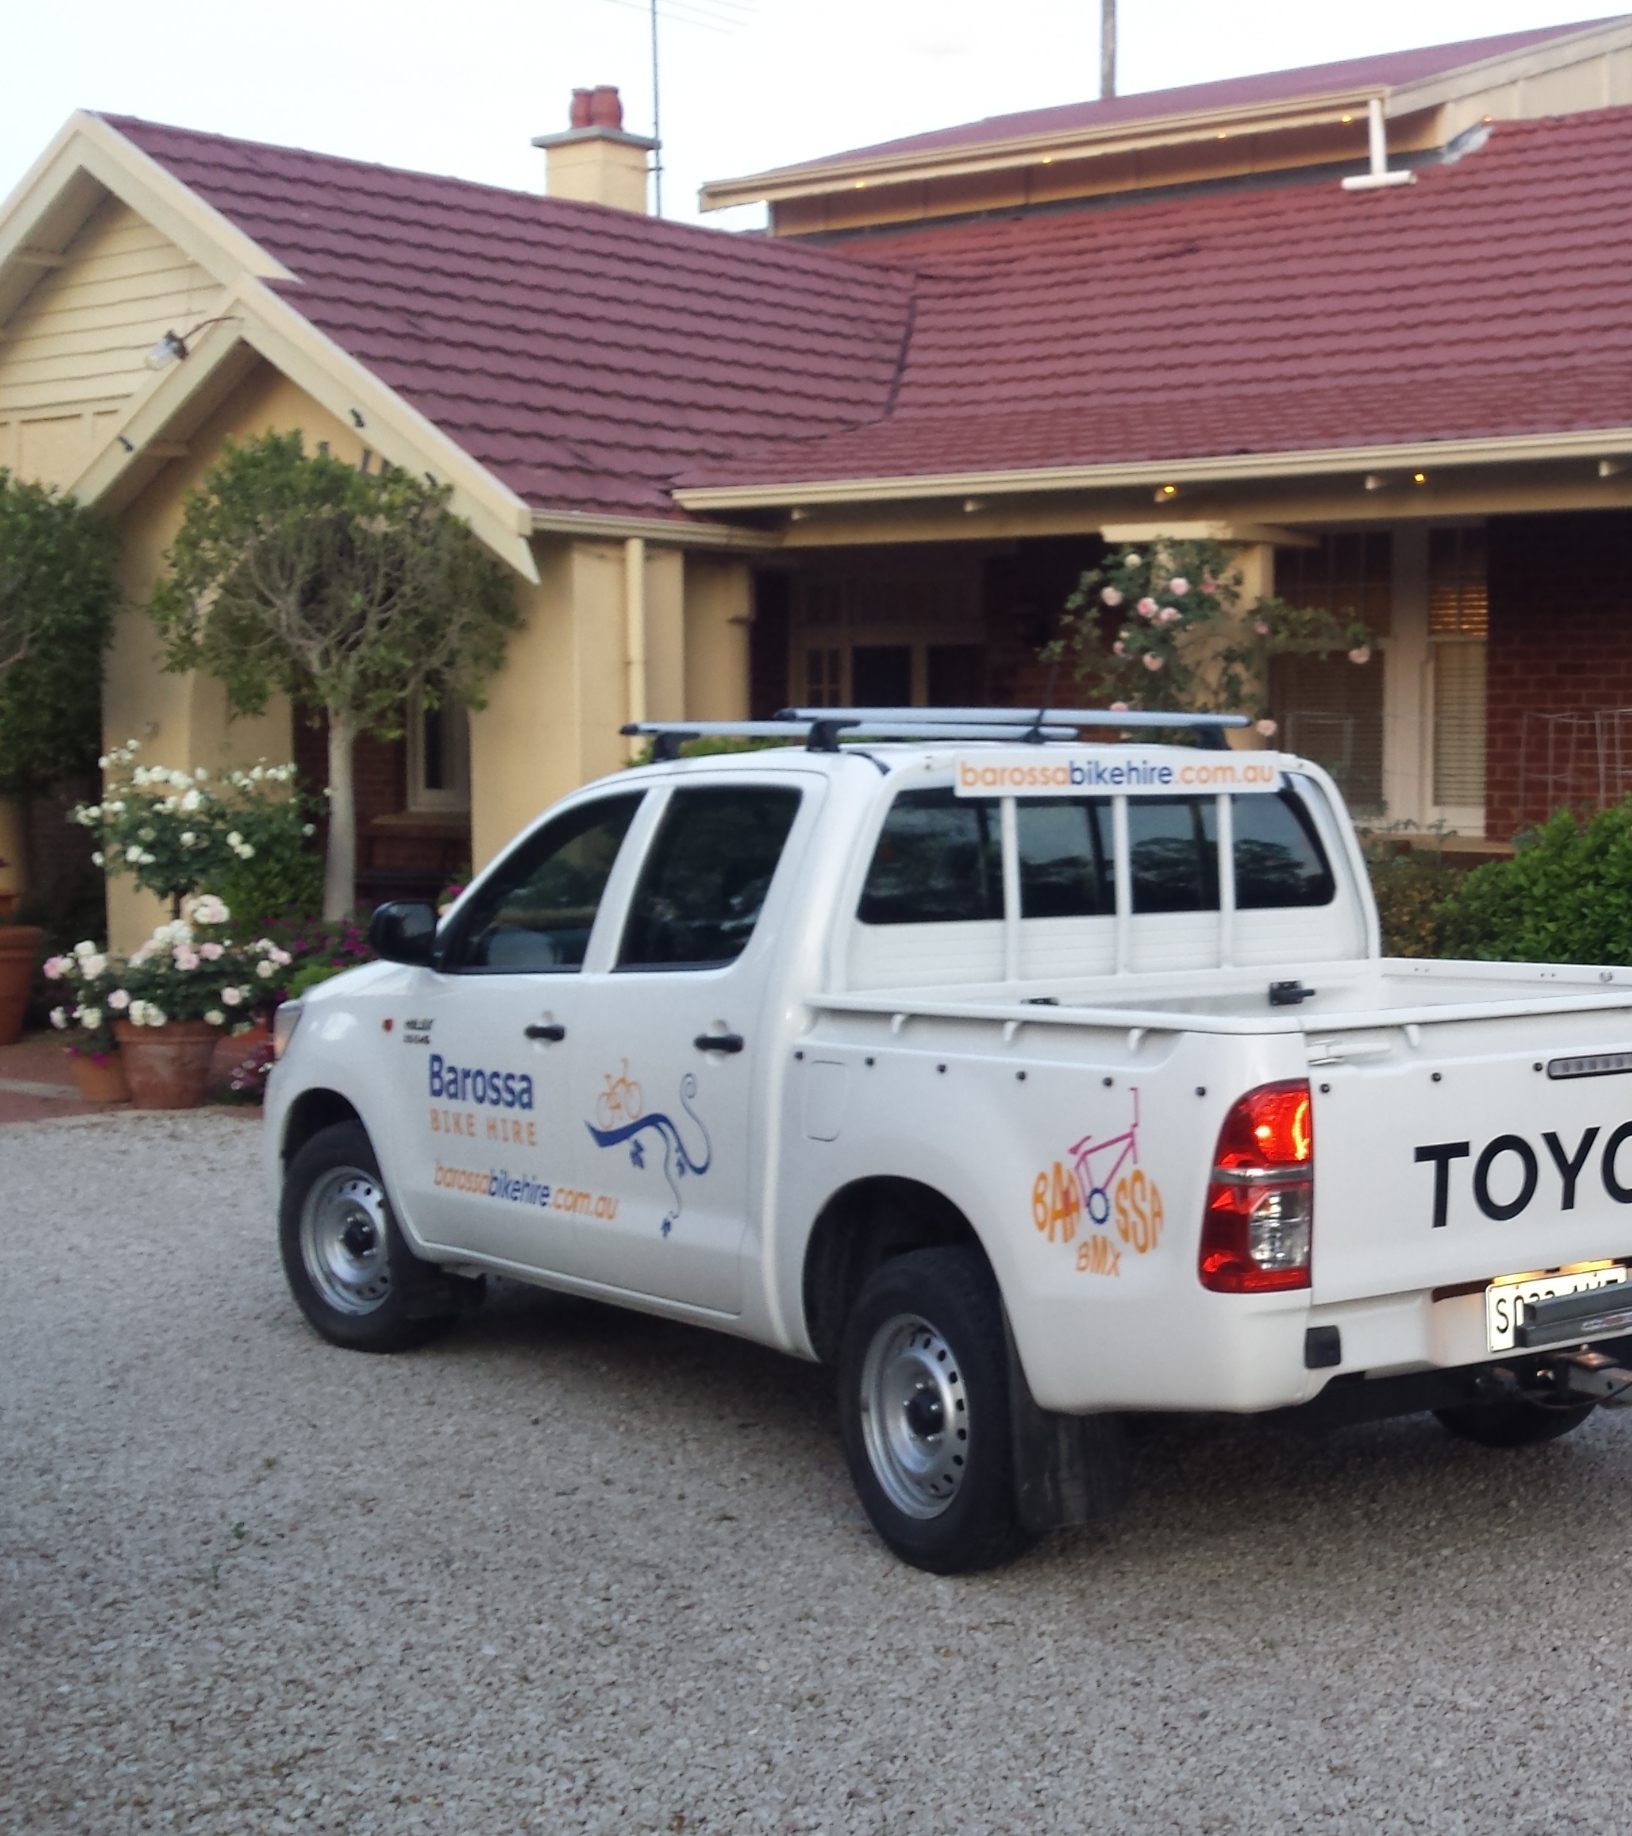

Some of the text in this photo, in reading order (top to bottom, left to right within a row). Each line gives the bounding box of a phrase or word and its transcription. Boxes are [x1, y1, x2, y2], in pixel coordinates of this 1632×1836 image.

[960, 759, 1274, 787] barossabikehire.com.au
[428, 1053, 534, 1111] Barossa
[429, 1108, 538, 1147] BIKE HIRE
[434, 1161, 620, 1221] barossabikehire.com.au
[1075, 1234, 1122, 1277] BMX
